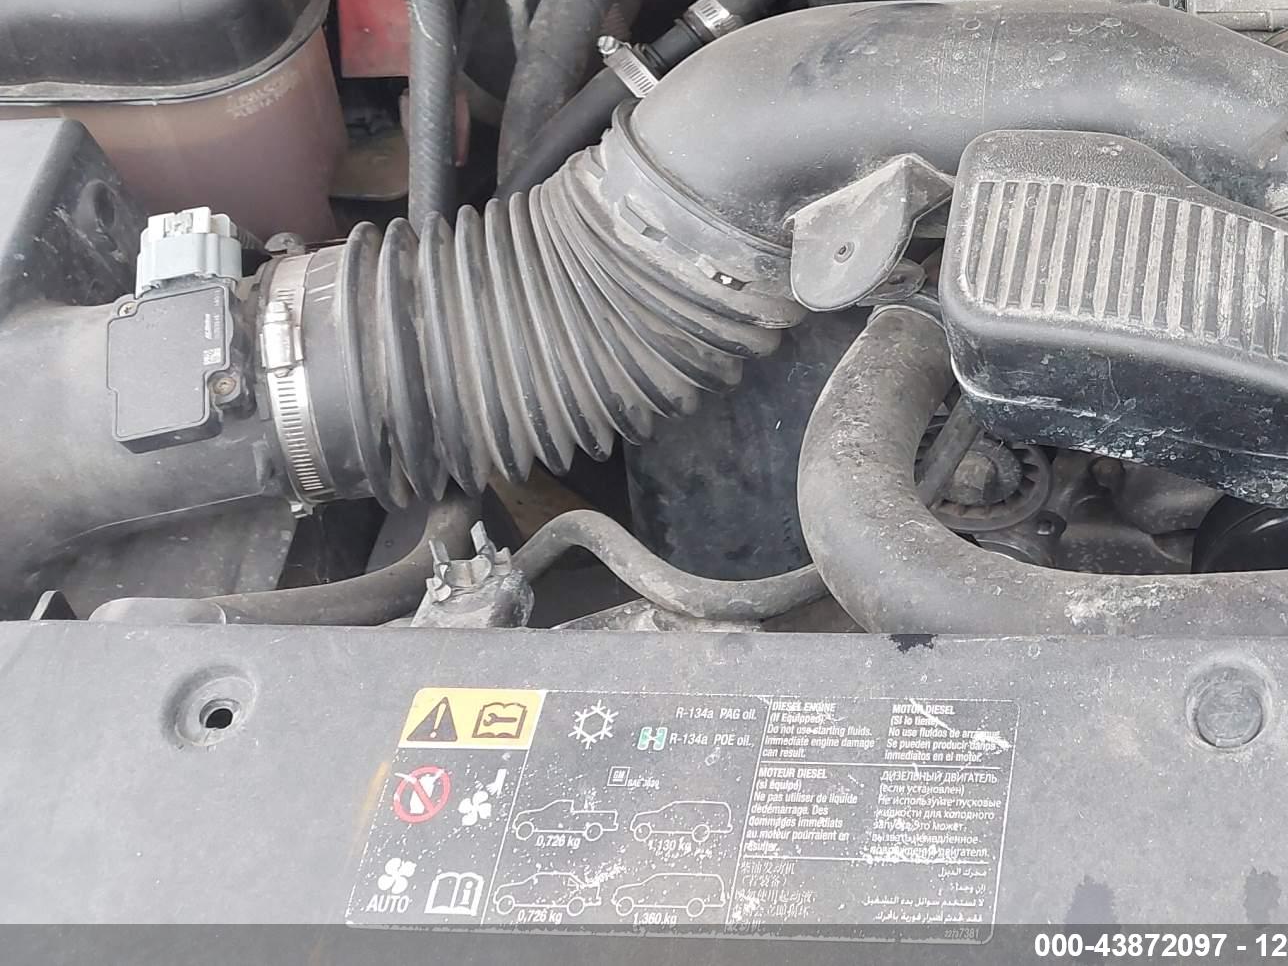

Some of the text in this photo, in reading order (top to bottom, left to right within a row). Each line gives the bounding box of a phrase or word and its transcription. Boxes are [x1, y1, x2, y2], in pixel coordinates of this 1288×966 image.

[772, 701, 836, 712] DIESEL ENGINE
[892, 704, 955, 715] MOTOR DIESEL
[676, 707, 757, 720] R-134a PAG oil.
[904, 716, 913, 724] lo
[767, 724, 778, 734] Do
[780, 724, 794, 734] not
[796, 726, 811, 735] use
[888, 727, 900, 737] No
[902, 729, 917, 737] use
[919, 728, 947, 739] fluidos
[949, 729, 960, 738] de
[669, 733, 708, 745] R-134a
[713, 734, 734, 746] POE
[765, 736, 874, 750] Immediate engine damage
[886, 738, 898, 748] Se
[899, 740, 931, 750] pueden
[932, 741, 968, 751] producir
[762, 749, 777, 757] can
[932, 752, 944, 761] en
[945, 751, 953, 761] el
[758, 767, 828, 779] MOTEUR DIESEL
[880, 770, 998, 784] ДИЗЕЛЬНЫЙ ДВИГАТЕЛЬ
[907, 784, 964, 797] установлен)
[754, 791, 858, 806] Ne pas utiliser de liquide
[878, 794, 890, 805] Не
[956, 797, 1002, 809] пусковые
[811, 804, 829, 815] Des
[923, 810, 942, 819] для
[944, 809, 995, 821] холодного
[748, 815, 843, 829] dommages immédiats
[567, 836, 580, 848] kg
[746, 829, 851, 843] au moteur pourraient en
[679, 838, 691, 852] kg
[365, 894, 410, 913] AUTO
[549, 911, 562, 924] kg
[664, 913, 677, 926] kg
